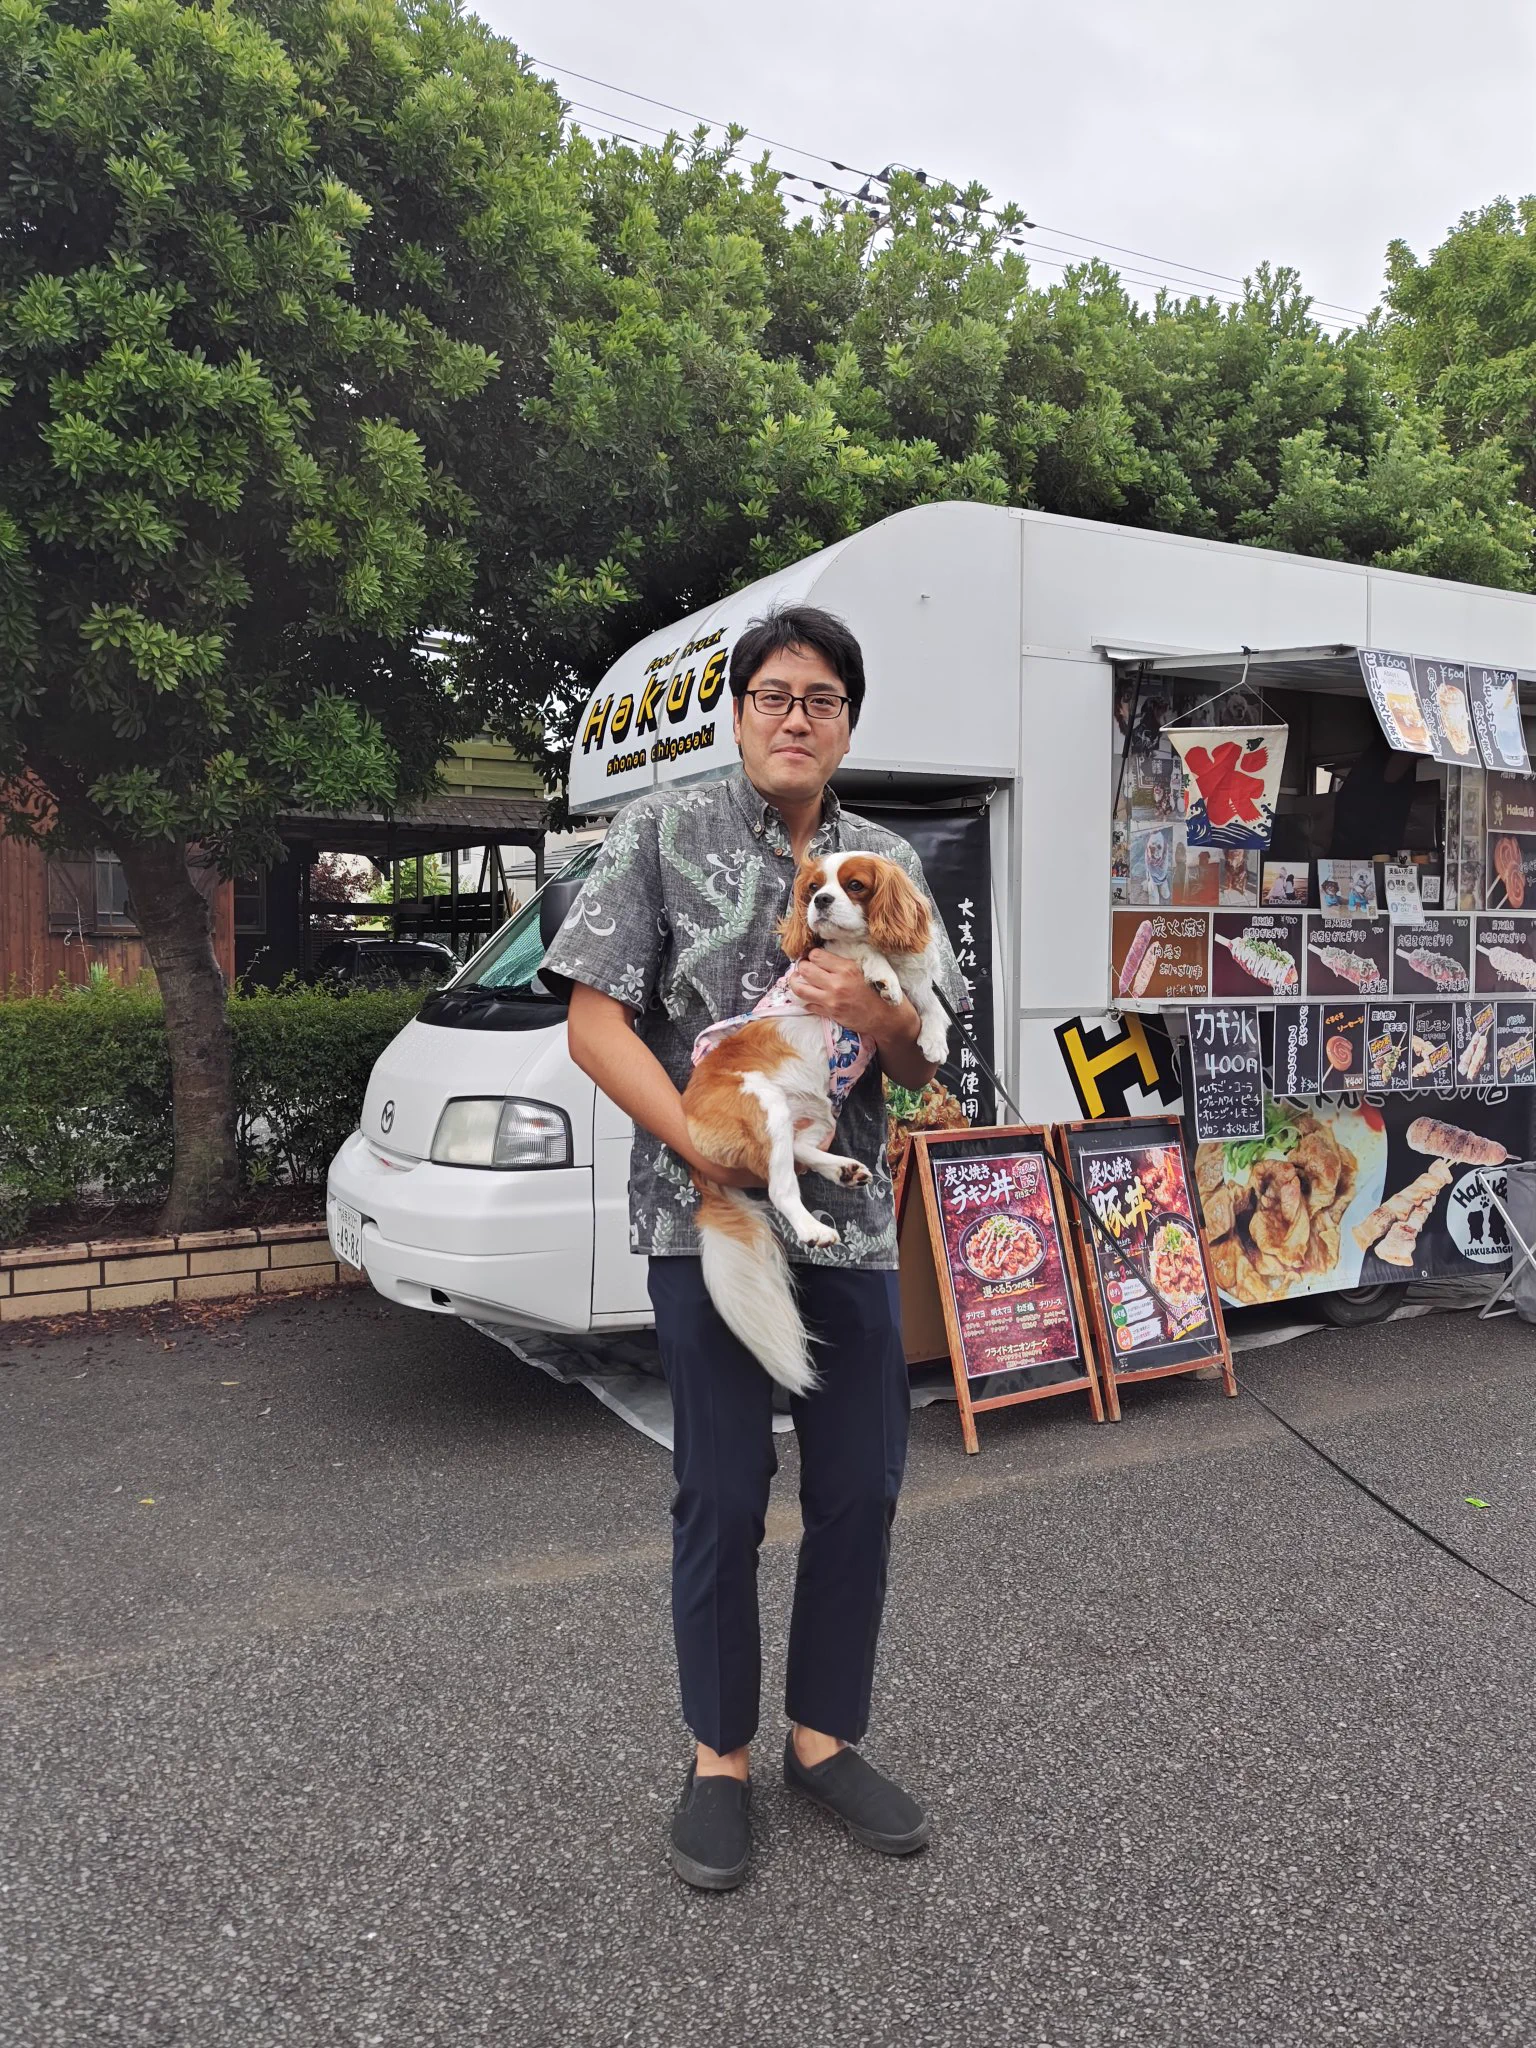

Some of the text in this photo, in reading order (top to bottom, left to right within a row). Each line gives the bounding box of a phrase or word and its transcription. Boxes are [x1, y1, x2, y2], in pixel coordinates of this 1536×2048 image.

[1378, 653, 1407, 669] ¥600
[1440, 664, 1464, 680] ¥500
[607, 722, 715, 776] shonan chigasaki
[1152, 916, 1206, 938] 炭火焼き
[1152, 944, 1182, 960] 肉巻き
[1195, 1008, 1257, 1046] カキ氷
[1416, 1020, 1450, 1032] 塩レモン
[1204, 1052, 1258, 1080] 400円
[1301, 1076, 1318, 1092] ¥300
[1345, 1077, 1363, 1088] ¥400
[944, 1163, 990, 1187] 炭火焼き
[1089, 1156, 1132, 1190] 炭火焼き
[951, 1169, 1015, 1214] チキン丼
[1092, 1176, 1152, 1238] 豚丼
[1464, 1246, 1513, 1256] HAKU&ANGI
[1016, 1302, 1035, 1313] ねぎ塩
[1039, 1299, 1062, 1309] チリソース
[985, 1338, 1048, 1358] フライドオニオンチーズ
